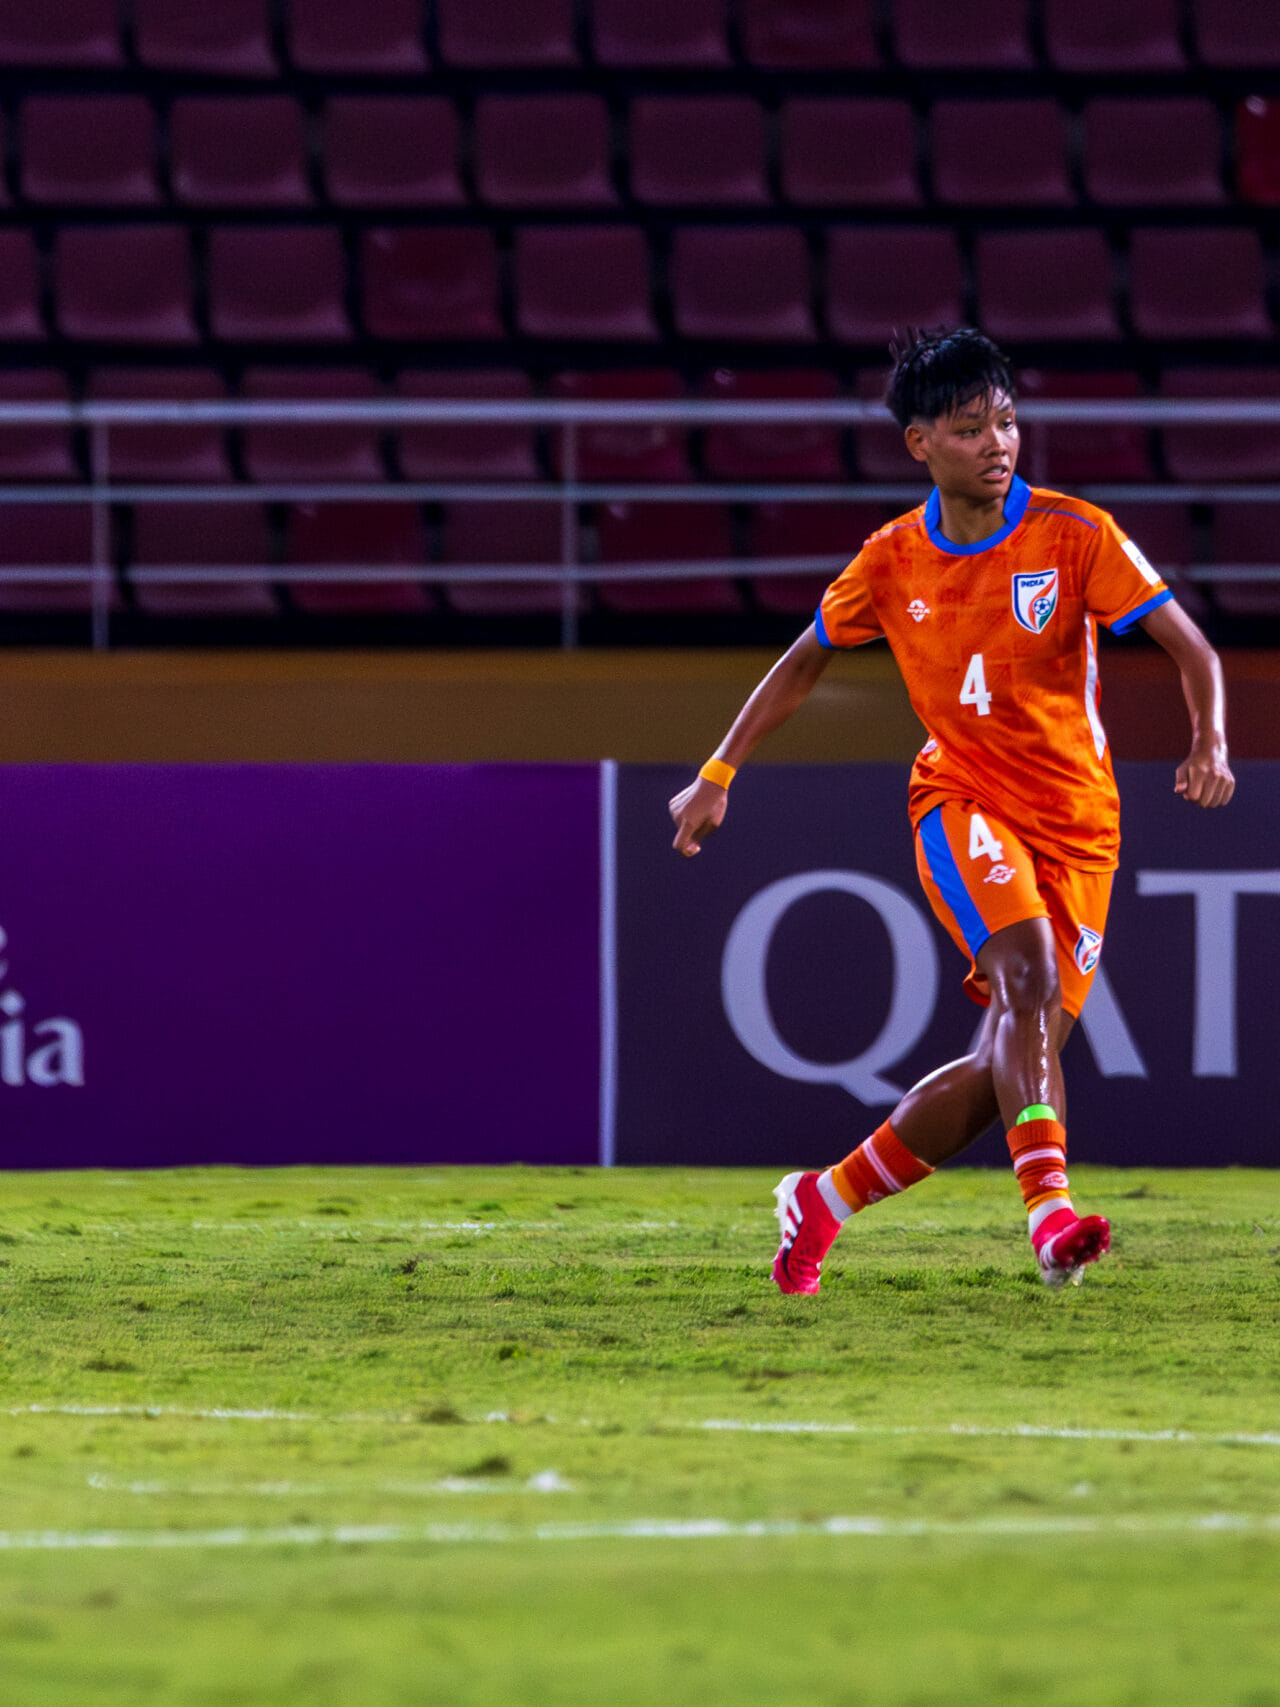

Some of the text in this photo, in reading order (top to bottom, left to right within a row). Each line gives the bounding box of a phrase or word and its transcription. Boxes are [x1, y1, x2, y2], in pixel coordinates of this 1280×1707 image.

[1021, 578, 1045, 588] INDIA
[959, 653, 993, 717] 4
[968, 813, 1004, 863] 4
